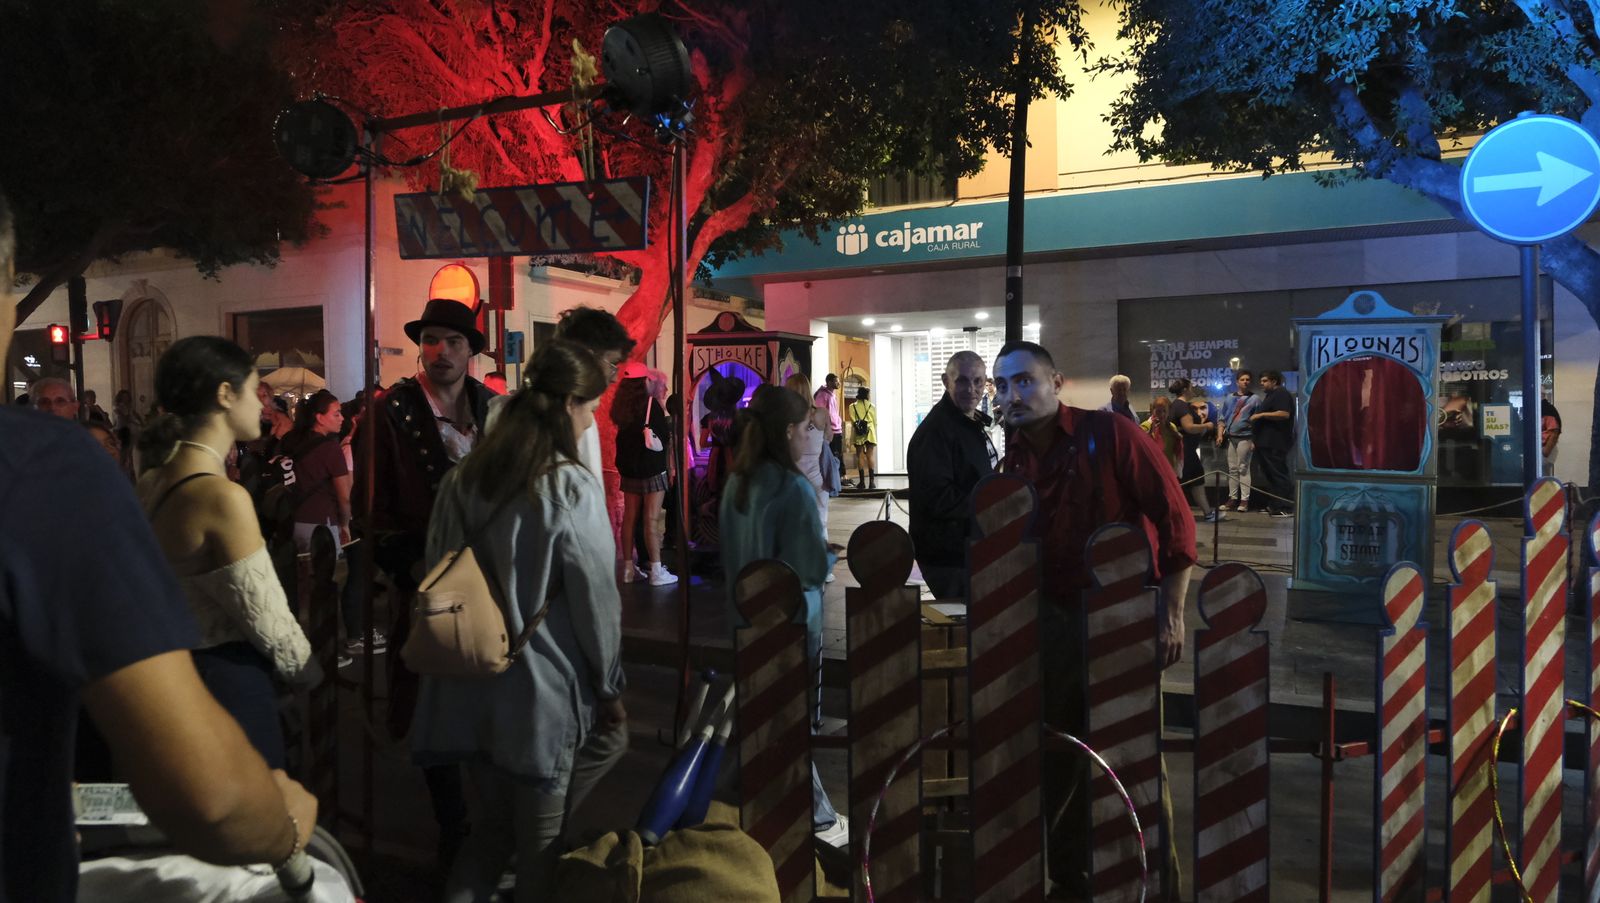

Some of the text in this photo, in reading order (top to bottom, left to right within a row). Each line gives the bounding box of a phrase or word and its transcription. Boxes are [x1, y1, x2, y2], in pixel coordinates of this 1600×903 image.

[875, 221, 984, 252] cajamar
[927, 240, 981, 252] CAJA RURAL
[1150, 339, 1239, 352] ESTAR SIEMPRE
[1150, 349, 1212, 361] A TU LADO
[1150, 360, 1183, 370] PARA
[1150, 367, 1233, 380] HACER BANCA
[1439, 369, 1508, 382] OSOTROS
[1150, 379, 1166, 388] DE
